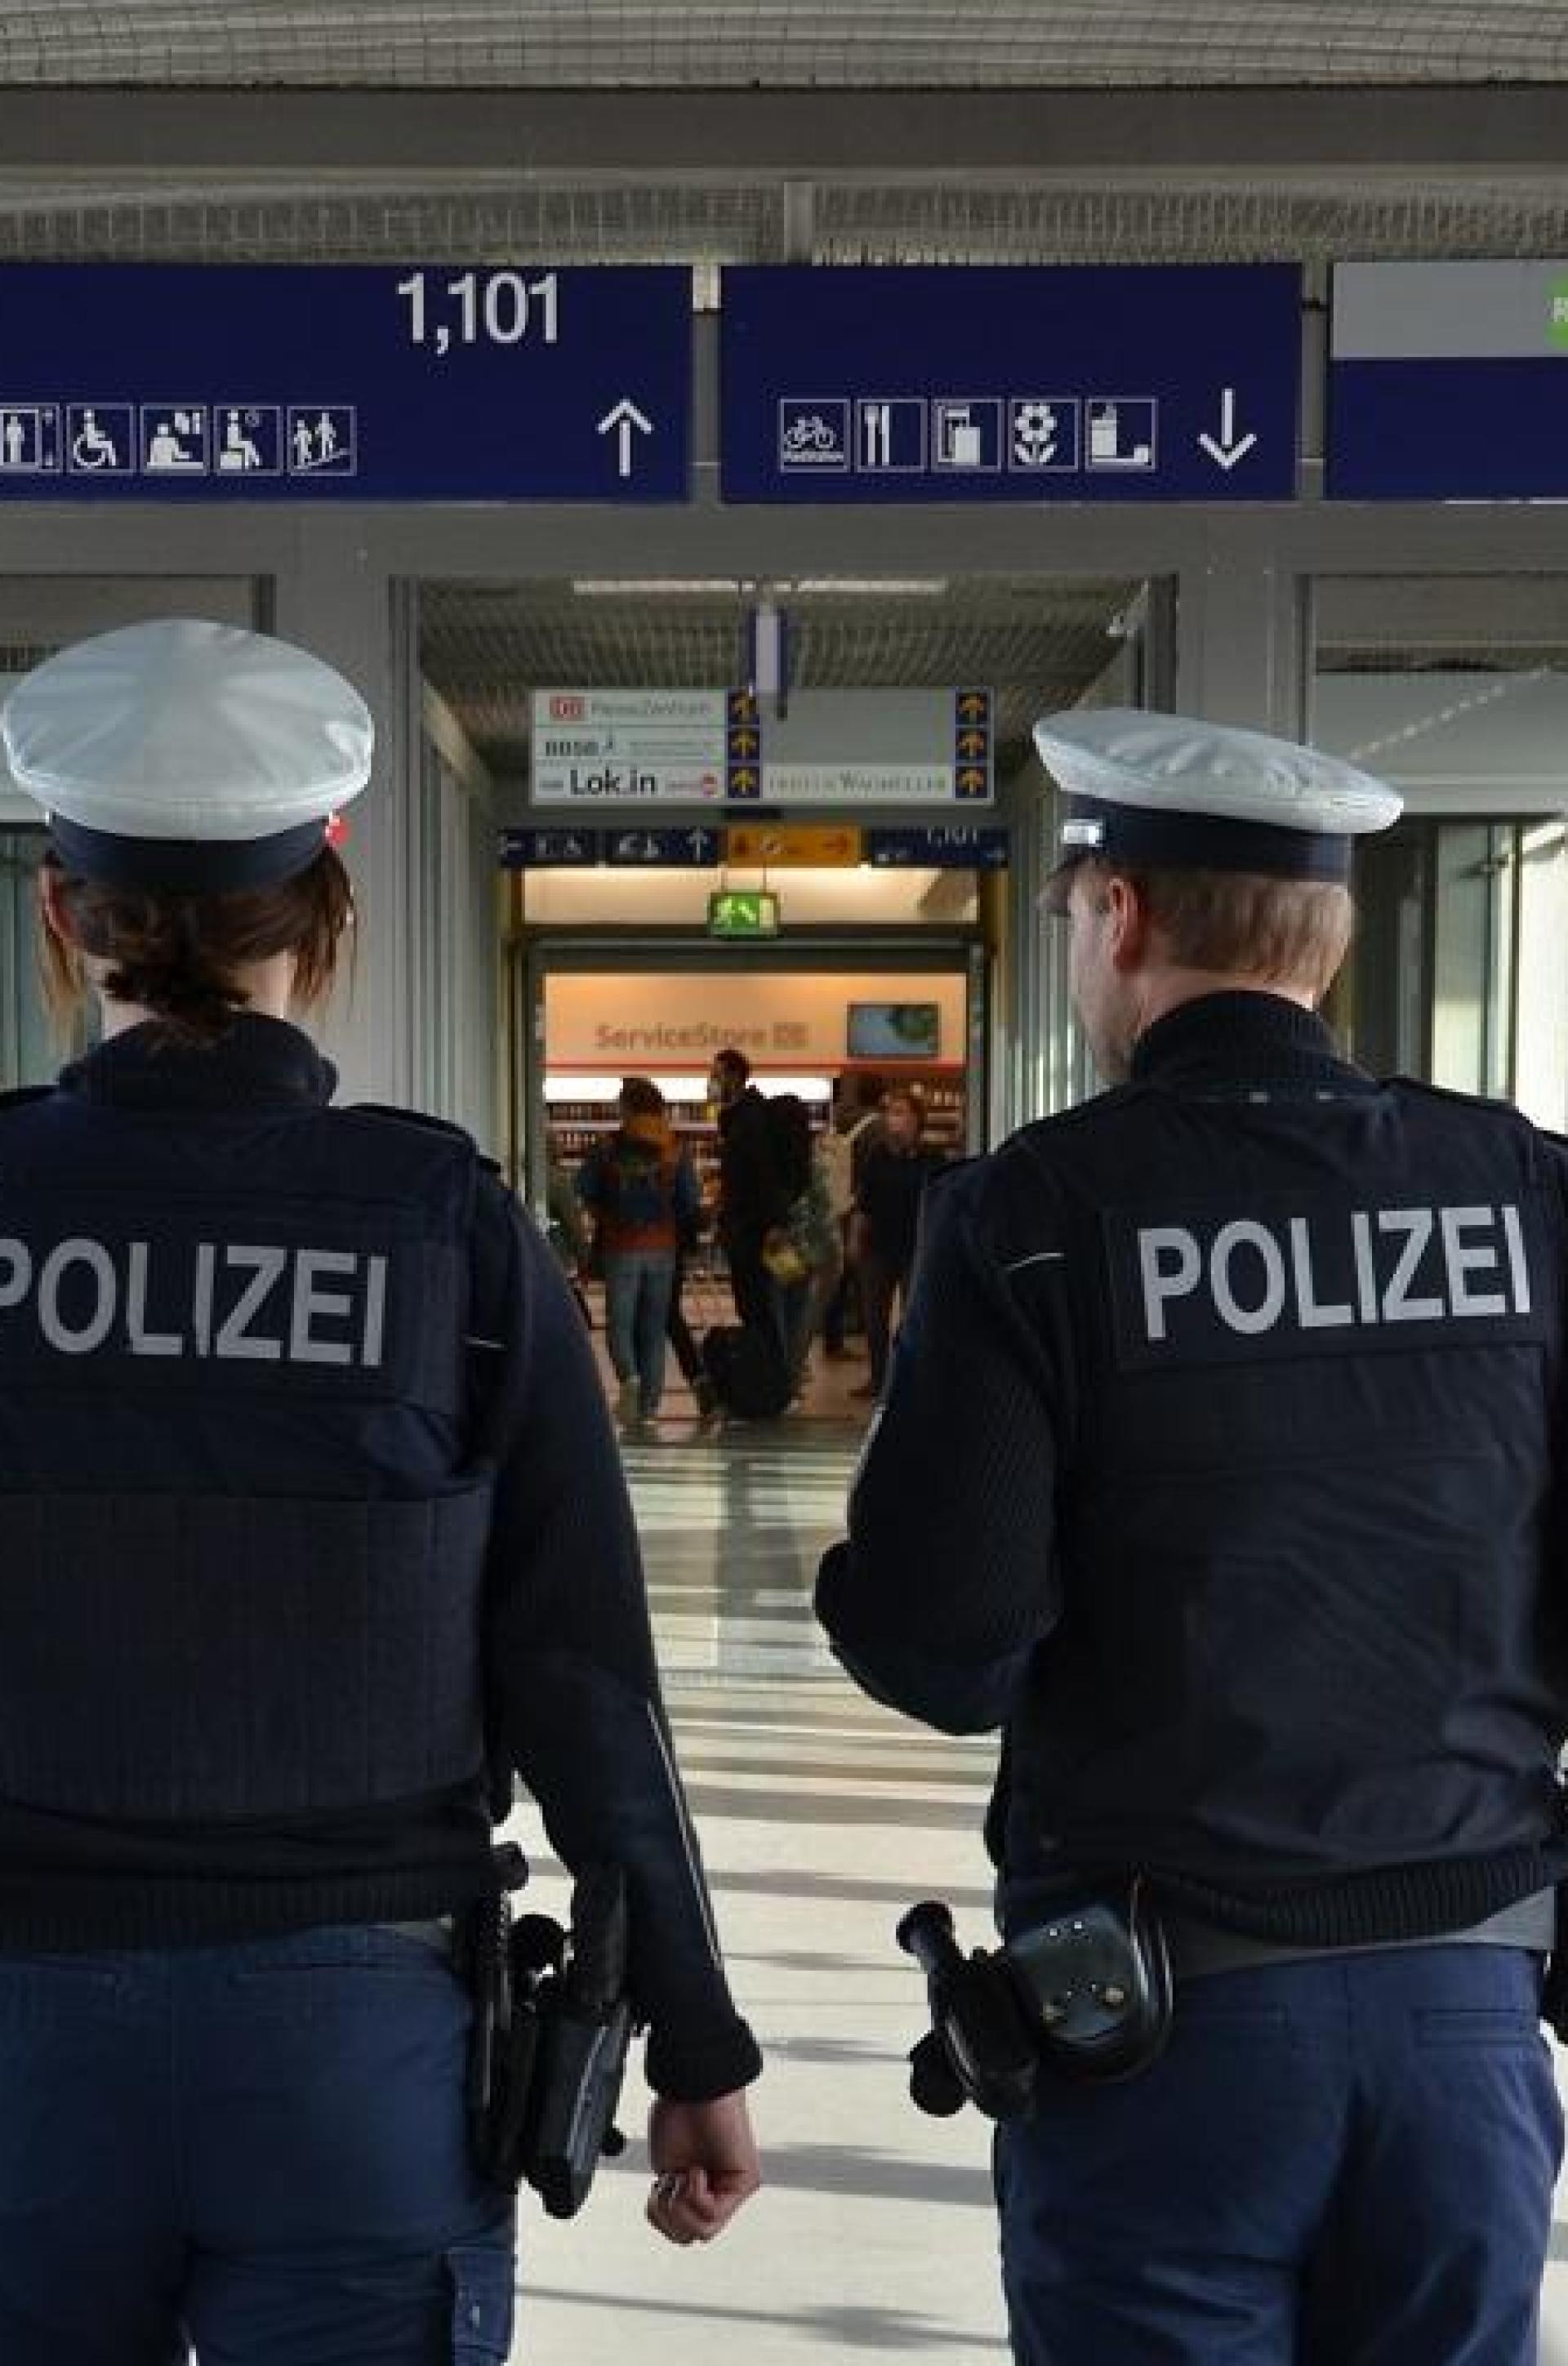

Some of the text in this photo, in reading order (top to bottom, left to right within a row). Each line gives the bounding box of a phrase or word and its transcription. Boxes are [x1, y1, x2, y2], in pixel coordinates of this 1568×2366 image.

[397, 273, 557, 356] 1,101
[570, 768, 657, 796] Lok.in
[595, 1022, 767, 1049] ServiceStore
[1138, 1204, 1531, 1339] POLIZEI
